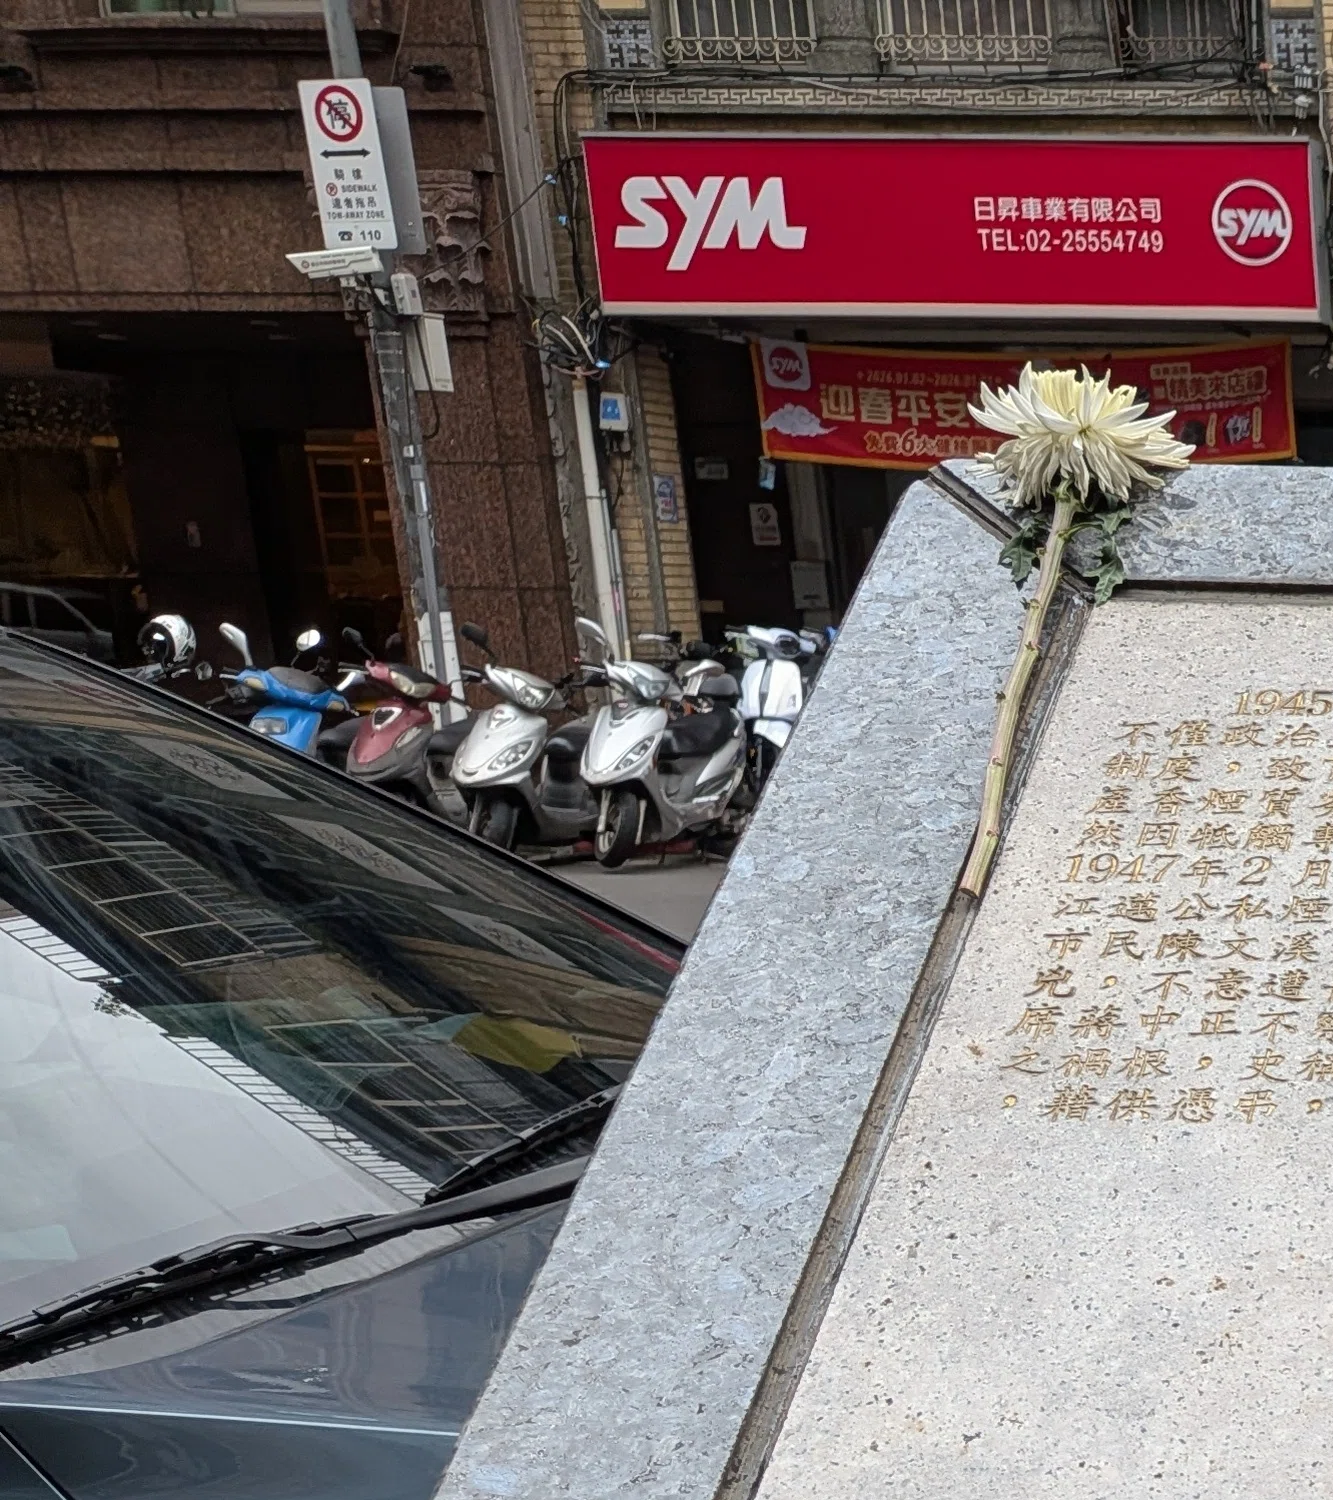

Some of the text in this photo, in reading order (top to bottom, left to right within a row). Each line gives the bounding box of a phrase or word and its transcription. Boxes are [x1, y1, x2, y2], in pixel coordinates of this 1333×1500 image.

[341, 184, 378, 193] SIDEWALK
[327, 210, 386, 220] TOW-AWAY ZONE
[973, 196, 1162, 224] 日昇車業有限公司
[614, 176, 807, 271] SYM
[1218, 207, 1289, 246] SYM
[360, 230, 381, 241] 110
[976, 228, 1164, 253] TEL:02-25554749
[770, 355, 804, 375] SYM
